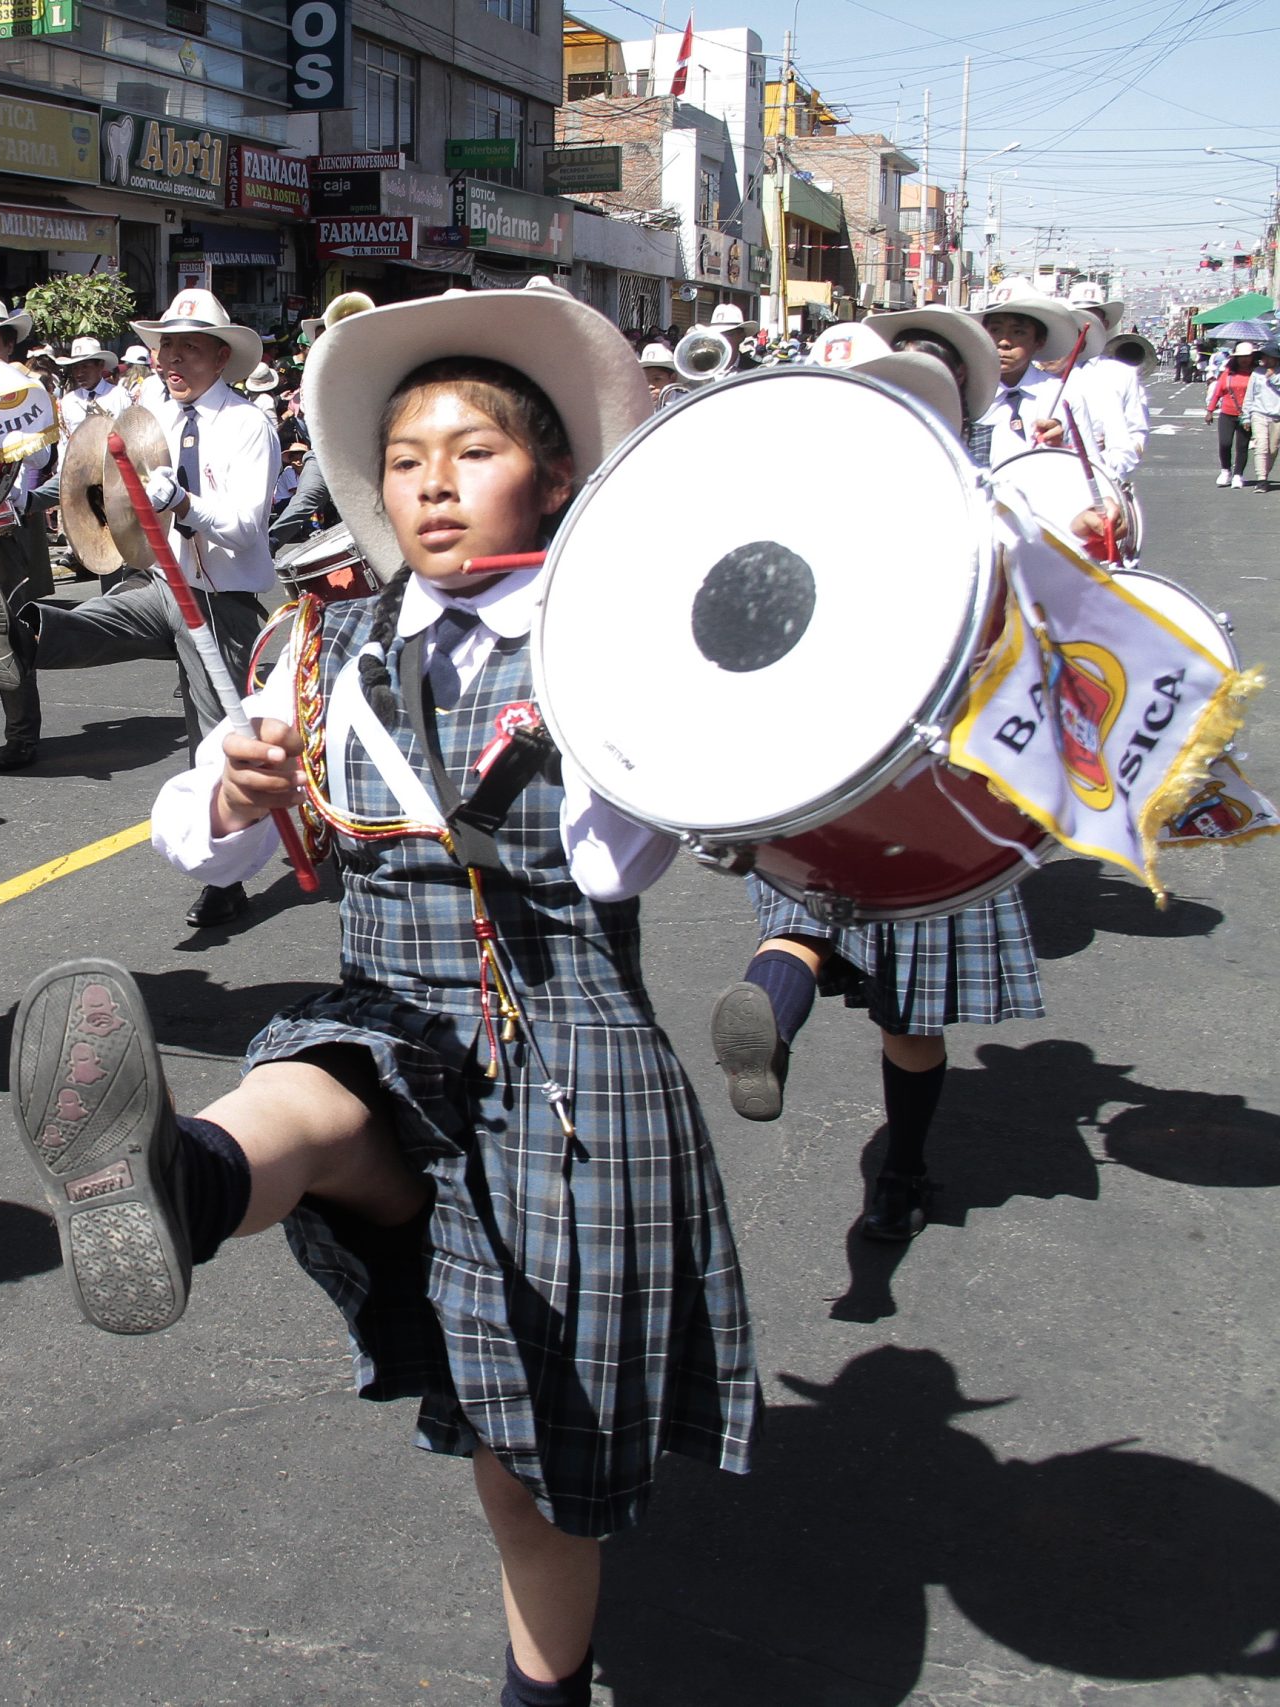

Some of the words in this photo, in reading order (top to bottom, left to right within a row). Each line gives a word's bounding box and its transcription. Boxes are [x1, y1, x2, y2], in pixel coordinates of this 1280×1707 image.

[139, 120, 222, 186] Abril
[352, 154, 398, 169] PROFESIONAL
[546, 150, 616, 165] BOTICA
[243, 151, 310, 189] FARMACIA
[245, 182, 273, 202] SANTA
[273, 187, 301, 206] ROSITA
[323, 178, 351, 193] caja
[470, 186, 496, 202] BOTICA
[0, 211, 88, 241] MILUFARMA
[320, 221, 409, 243] FARMACIA
[470, 202, 540, 242] Biofarma
[370, 246, 398, 255] ROSITA
